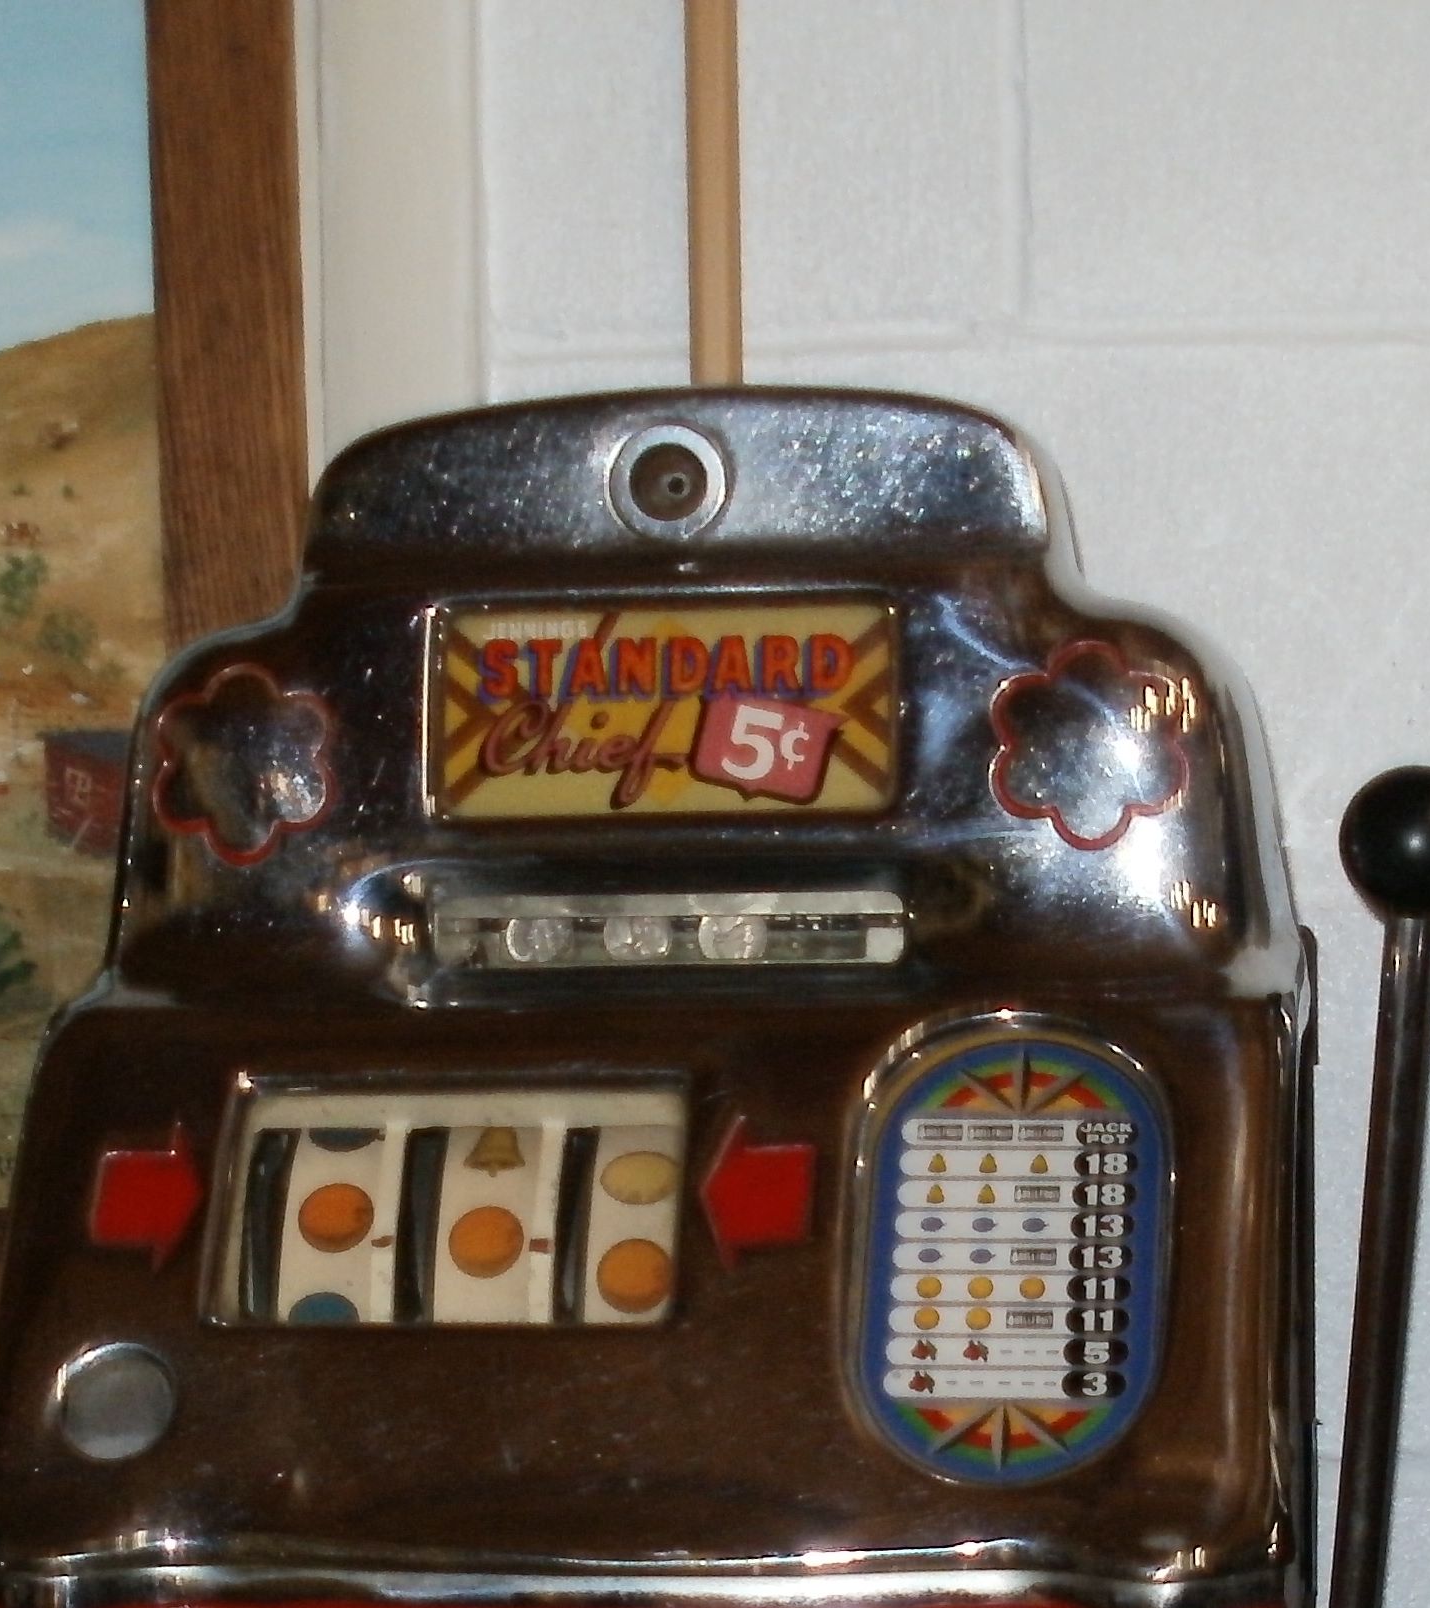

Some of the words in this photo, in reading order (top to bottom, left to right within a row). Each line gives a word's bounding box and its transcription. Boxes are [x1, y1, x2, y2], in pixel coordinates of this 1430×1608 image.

[483, 620, 587, 640] JENNINGS
[480, 634, 855, 701] STANDARD
[721, 703, 812, 780] 5¢
[479, 701, 686, 809] Chief
[1081, 1122, 1133, 1133] JACK
[1086, 1134, 1128, 1145] POT
[1085, 1153, 1129, 1175] 18
[1084, 1184, 1127, 1206] 18
[1082, 1214, 1124, 1236] 13
[1081, 1245, 1123, 1268] 13
[1084, 1277, 1116, 1299] 11
[1082, 1308, 1114, 1331] 11
[1083, 1341, 1110, 1364] 5
[1083, 1373, 1108, 1396] 3
